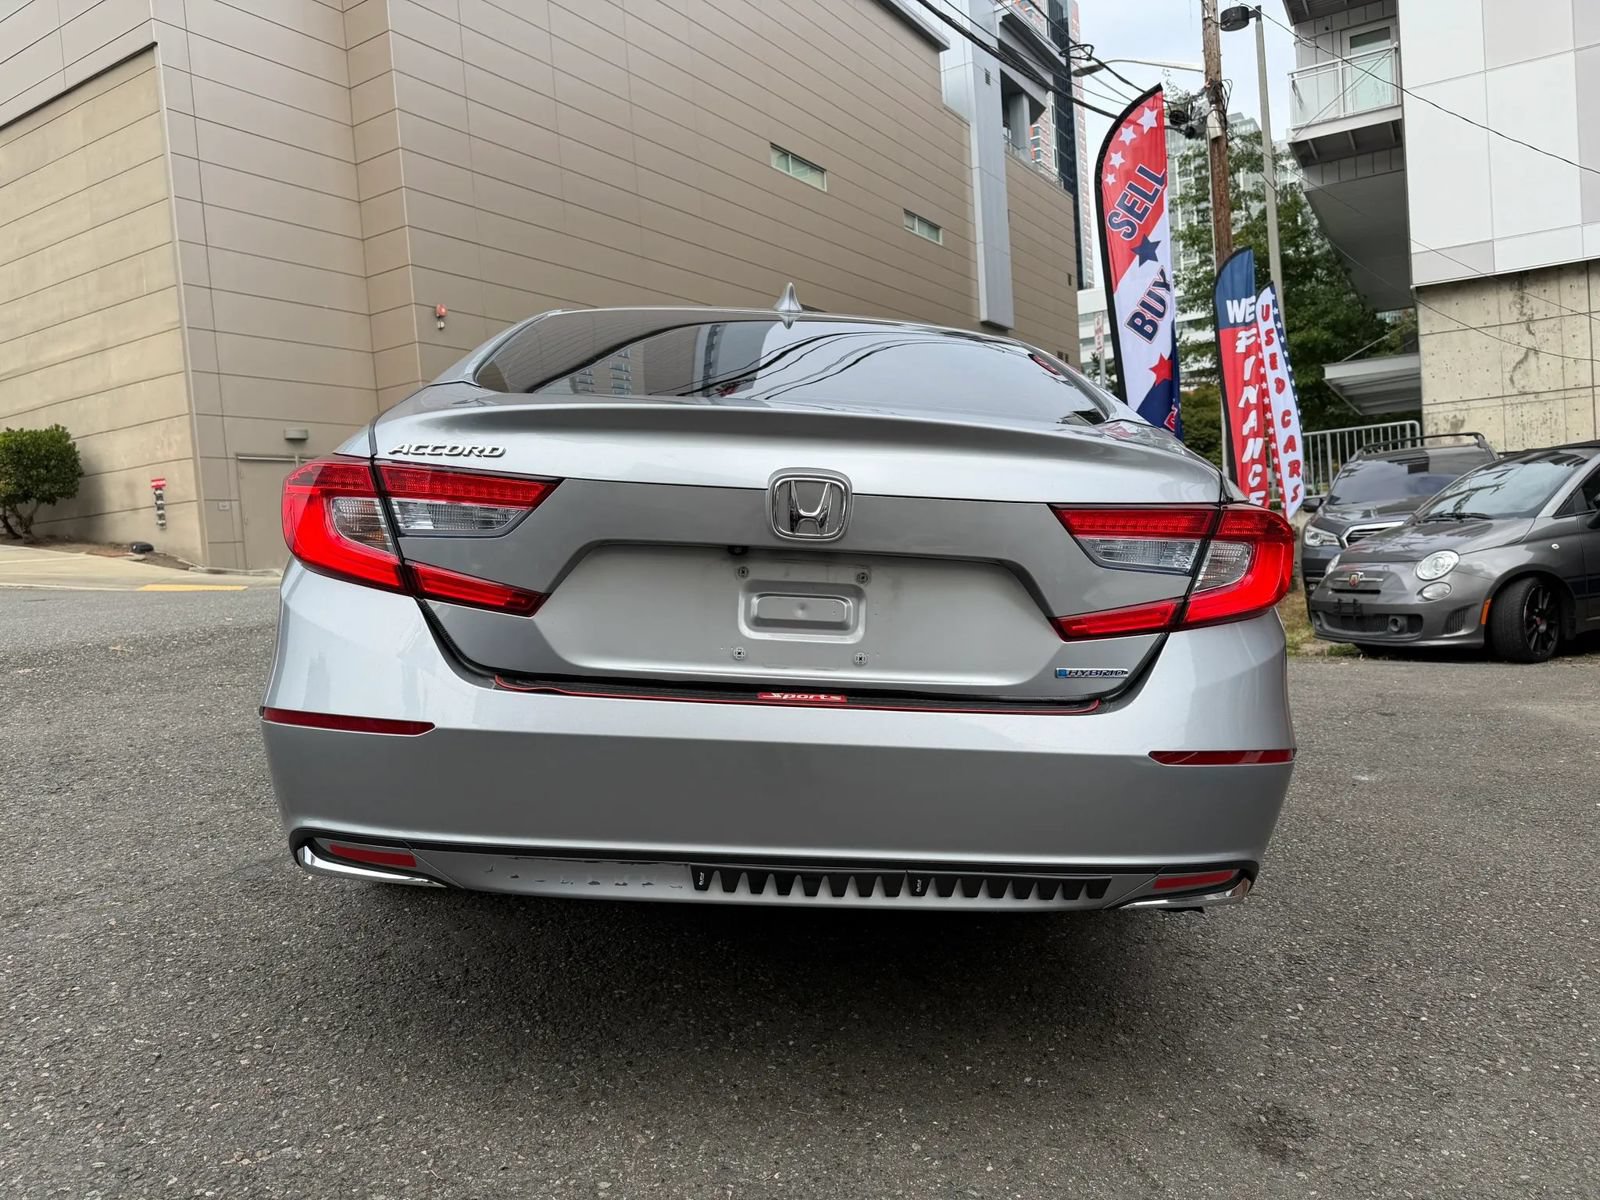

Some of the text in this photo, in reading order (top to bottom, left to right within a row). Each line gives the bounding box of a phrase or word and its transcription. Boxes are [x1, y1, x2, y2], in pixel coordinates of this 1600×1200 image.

[1107, 163, 1167, 240] SELL
[1124, 265, 1172, 345] BUY
[1226, 295, 1257, 324] WE
[1261, 303, 1302, 503] USED CARS
[388, 443, 507, 459] ACCORD
[1068, 668, 1127, 678] HYBRID
